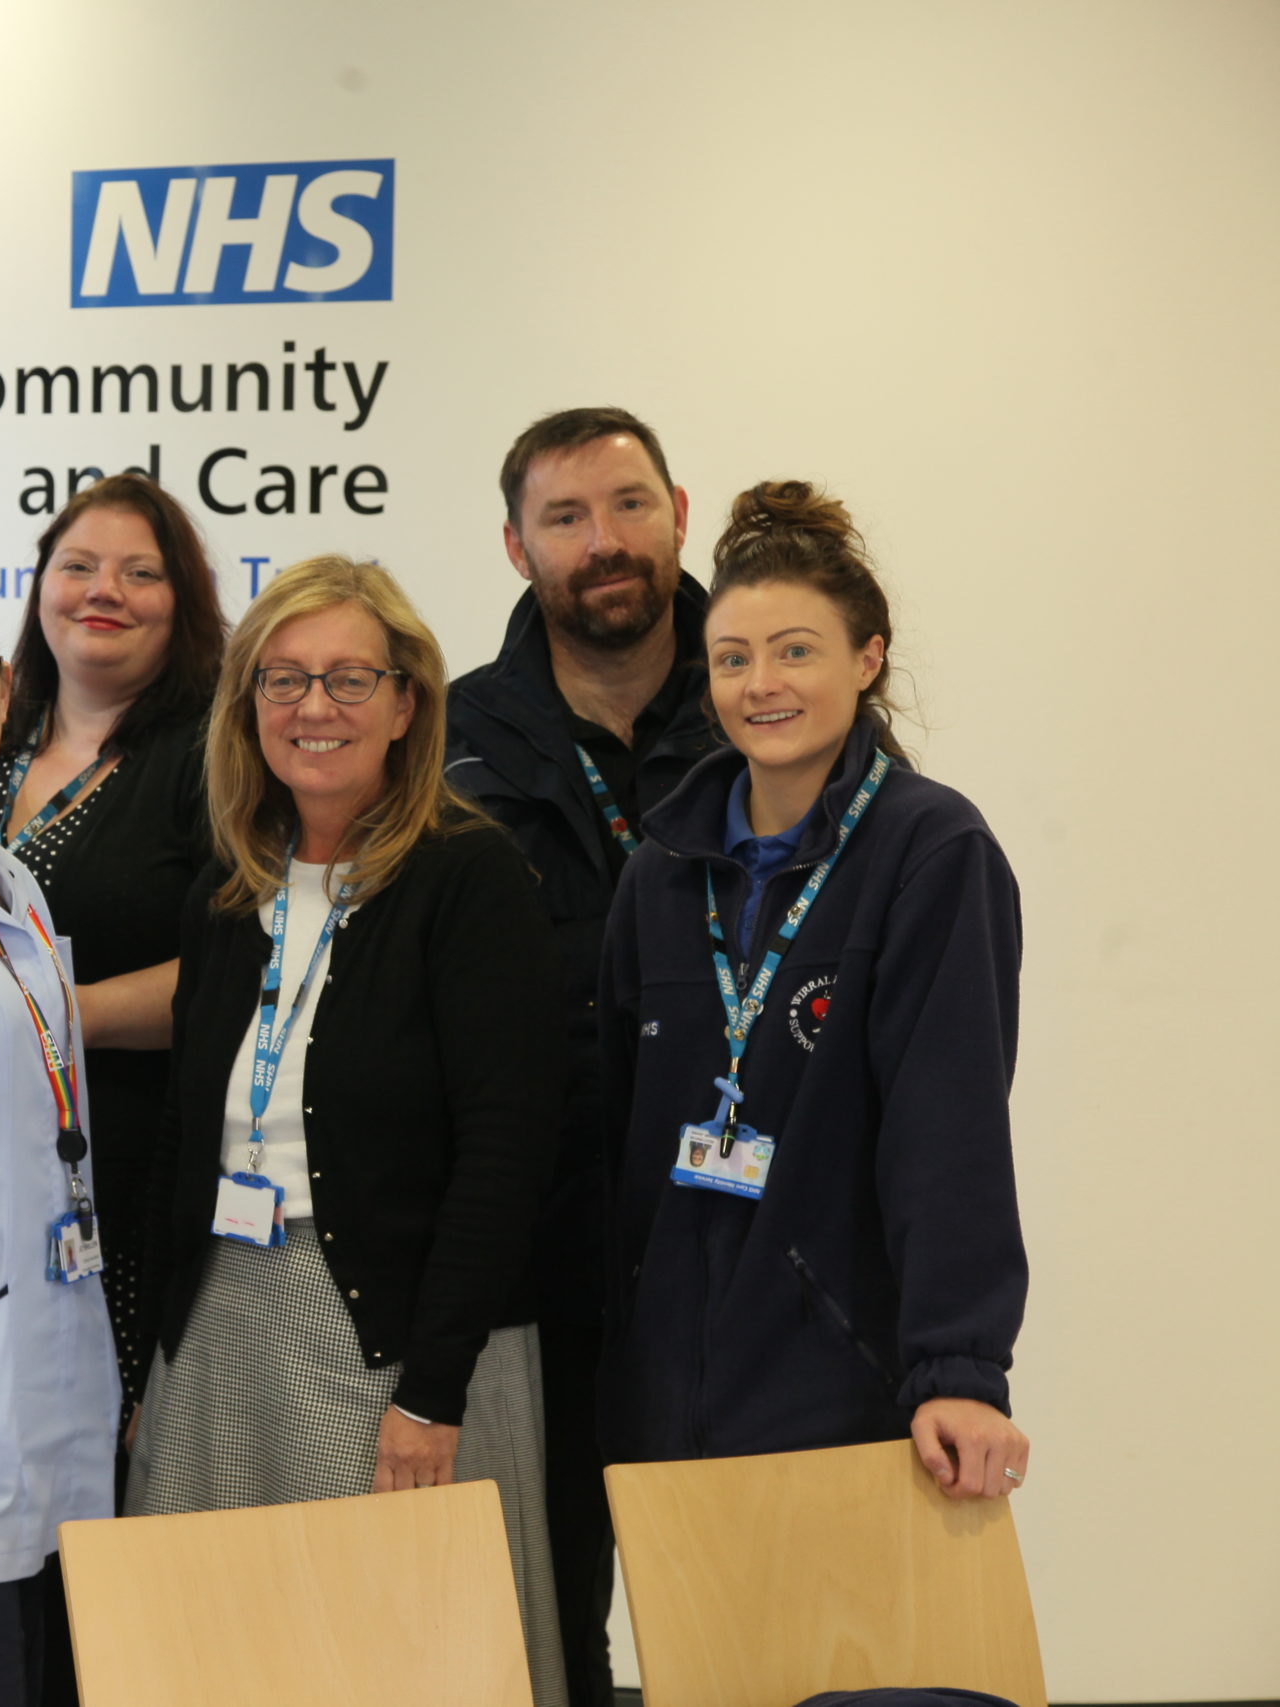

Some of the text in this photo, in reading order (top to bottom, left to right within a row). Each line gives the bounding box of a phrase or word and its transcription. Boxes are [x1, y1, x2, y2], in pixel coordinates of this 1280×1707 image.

[79, 169, 384, 298] NHS
[198, 447, 389, 514] Care
[869, 758, 887, 785] NHS
[848, 789, 870, 819] NHS
[24, 816, 44, 836] NS
[809, 862, 829, 891] NHS
[274, 910, 284, 935] NHS
[325, 909, 342, 935] NHS
[270, 944, 282, 969] NHS
[720, 968, 735, 995] NHS
[752, 968, 772, 999] NHS
[791, 976, 831, 1005] WIRRAL
[258, 1023, 271, 1051] NHS
[273, 1028, 287, 1054] NHS
[254, 1059, 266, 1087] NHS
